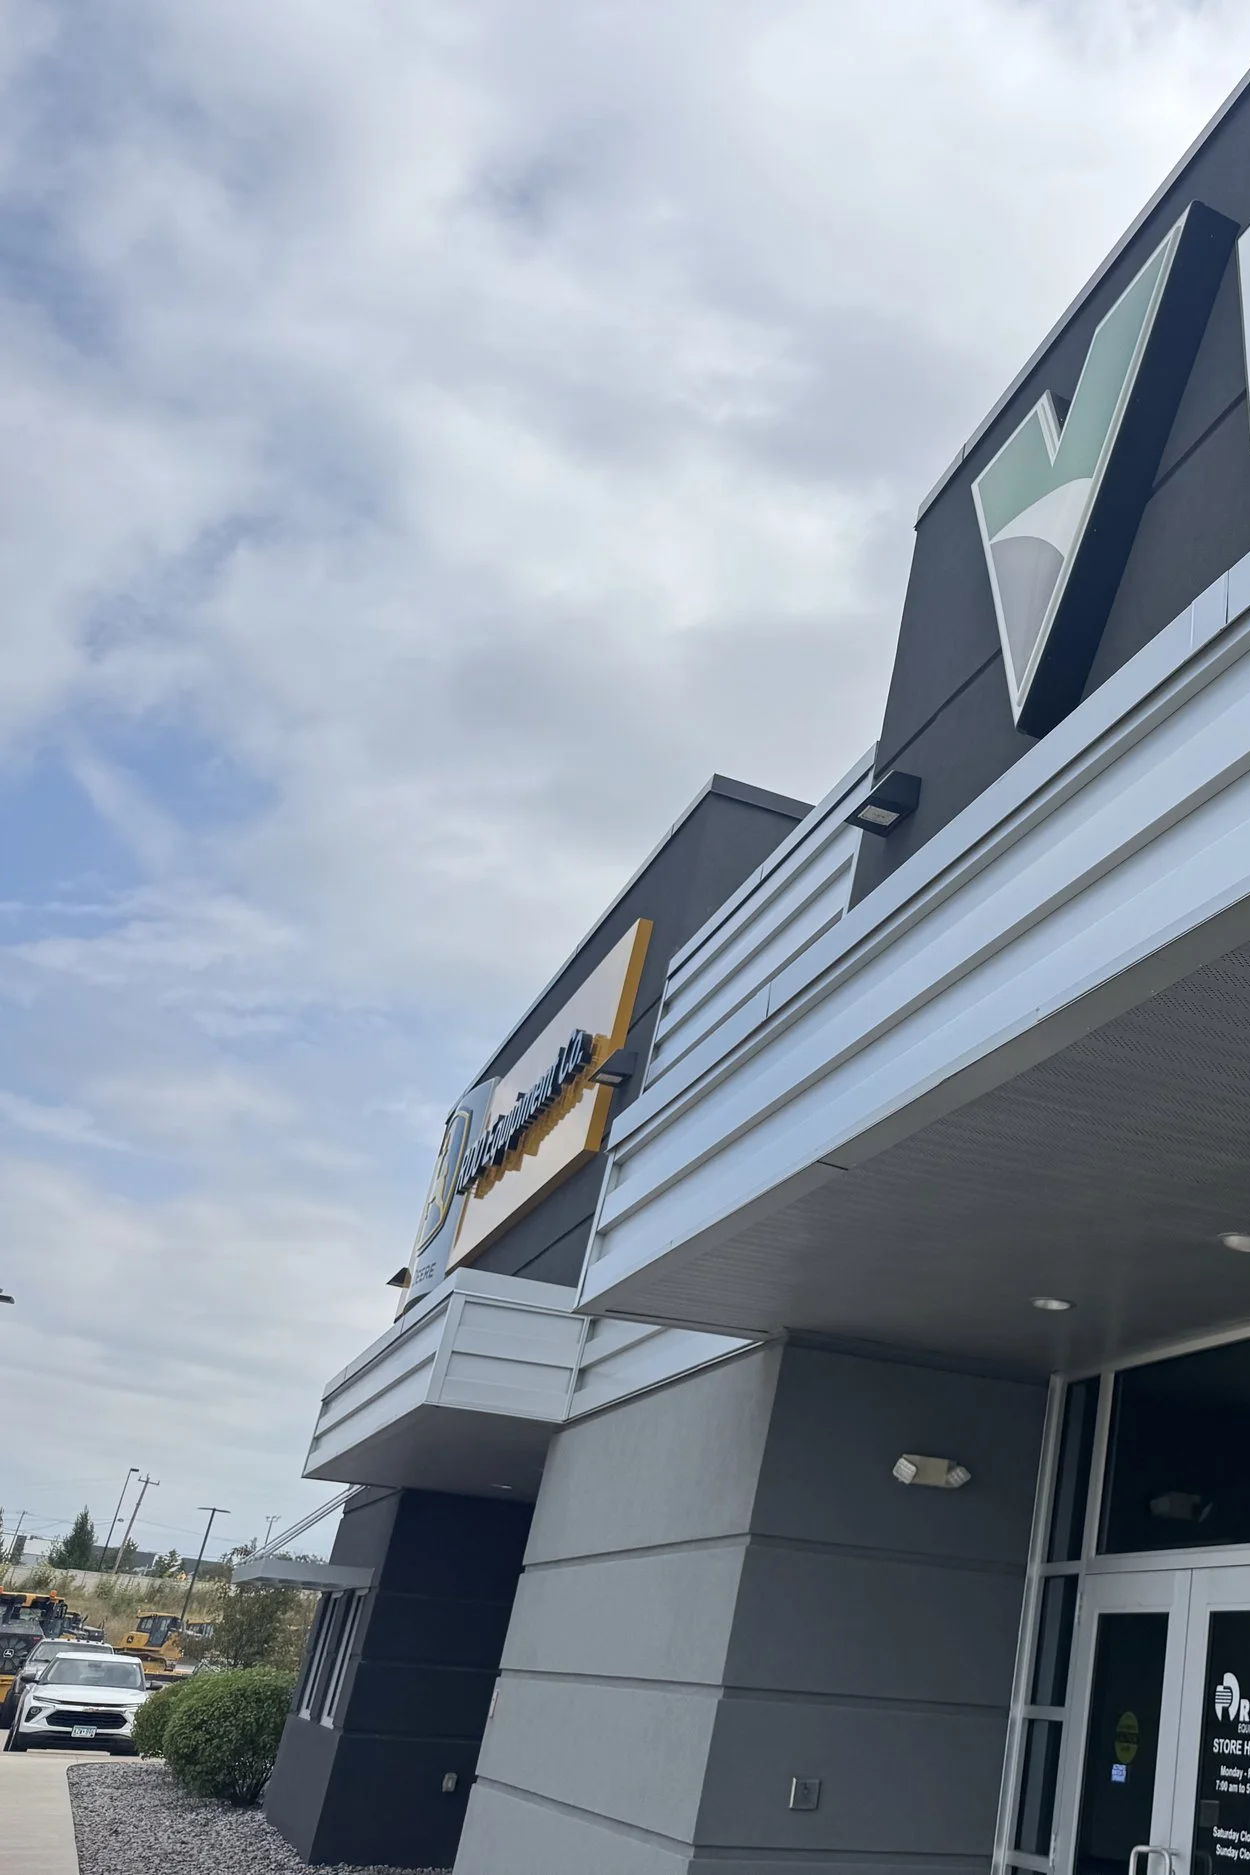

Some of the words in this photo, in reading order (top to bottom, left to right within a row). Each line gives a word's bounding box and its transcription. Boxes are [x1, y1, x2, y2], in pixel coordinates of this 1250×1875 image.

[1212, 1738, 1242, 1755] STORE
[1220, 1765, 1243, 1780] Monday
[1215, 1780, 1228, 1791] 7:00
[1228, 1783, 1238, 1793] am
[1238, 1783, 1246, 1794] to
[1212, 1826, 1239, 1843] Saturday
[1215, 1843, 1238, 1861] Sunday
